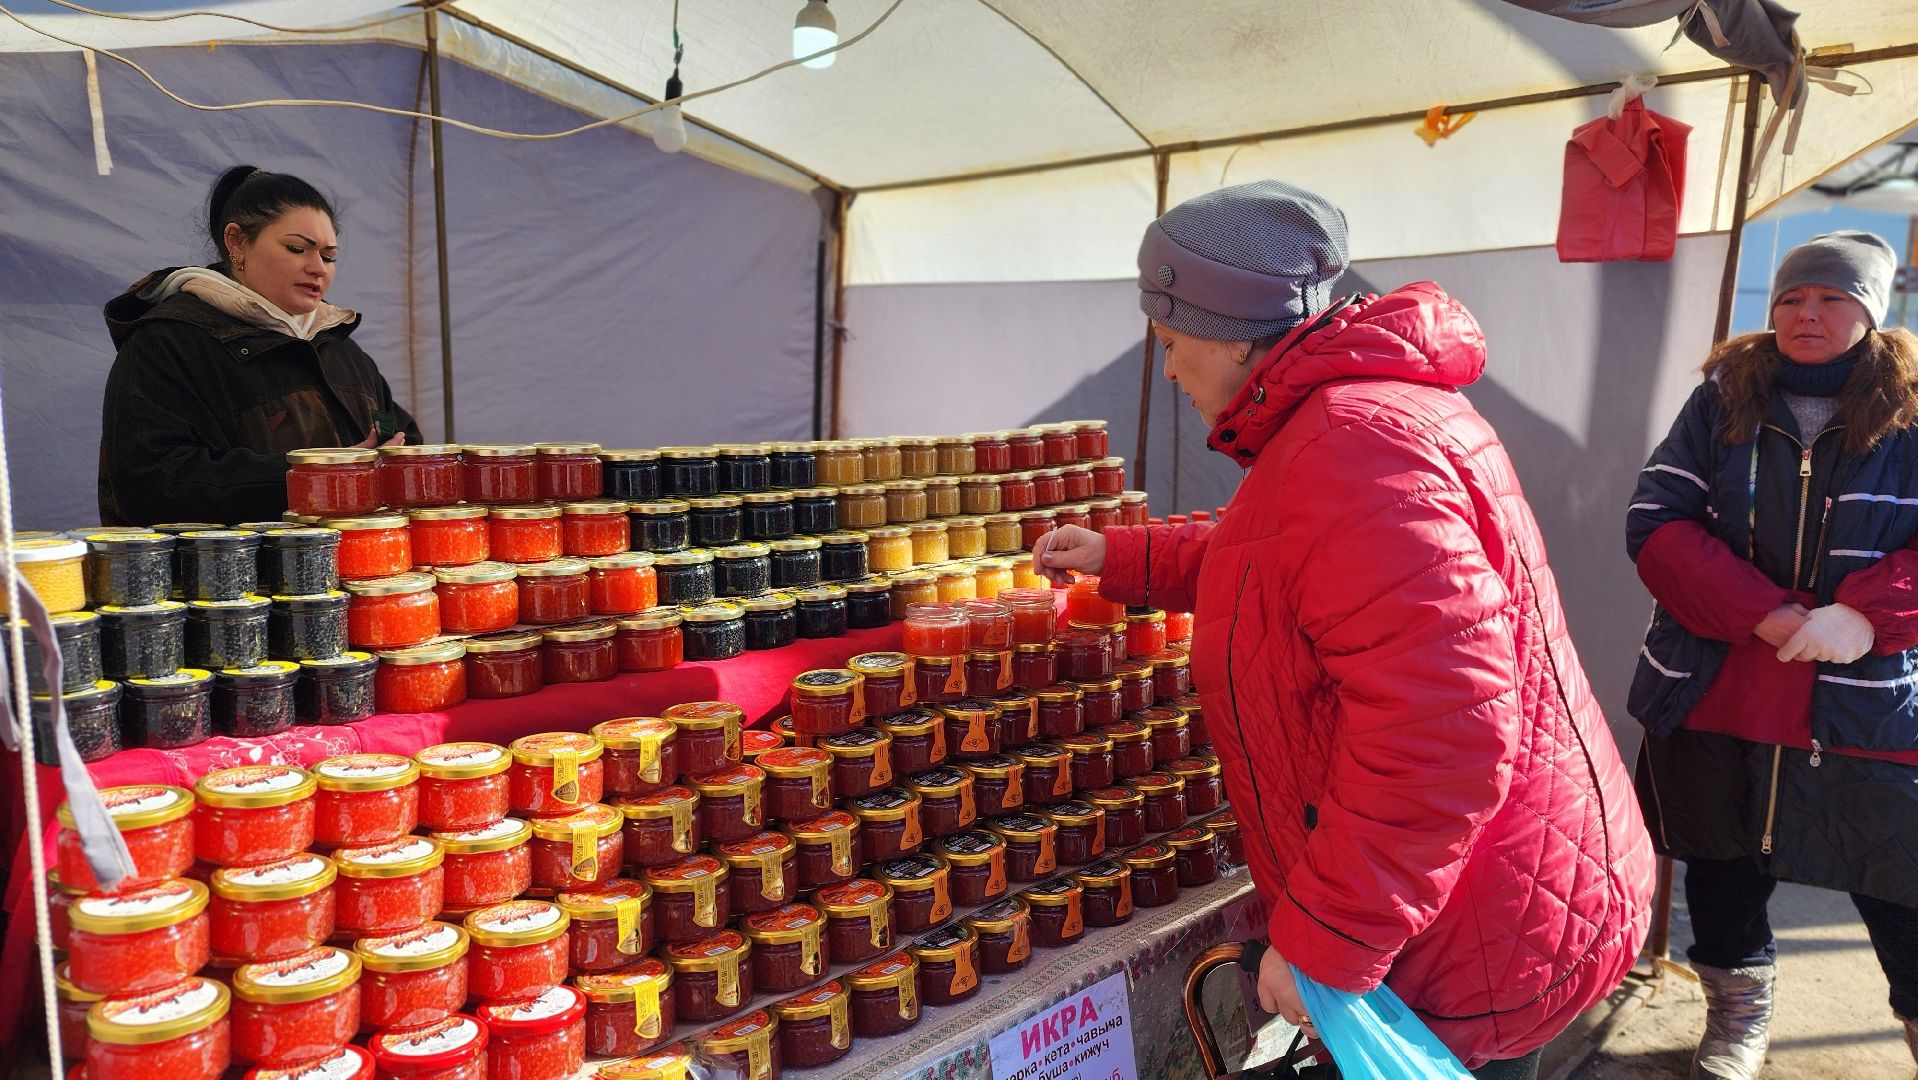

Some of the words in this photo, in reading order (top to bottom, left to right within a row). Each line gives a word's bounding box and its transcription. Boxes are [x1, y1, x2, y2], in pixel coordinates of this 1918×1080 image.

[1006, 1061, 1038, 1080] ерка
[1044, 1043, 1070, 1066] кета
[1076, 1015, 1123, 1046] чавыча
[1021, 995, 1099, 1060] ИКРА
[1039, 1061, 1069, 1080] буша
[1074, 1039, 1110, 1066] кижуч
